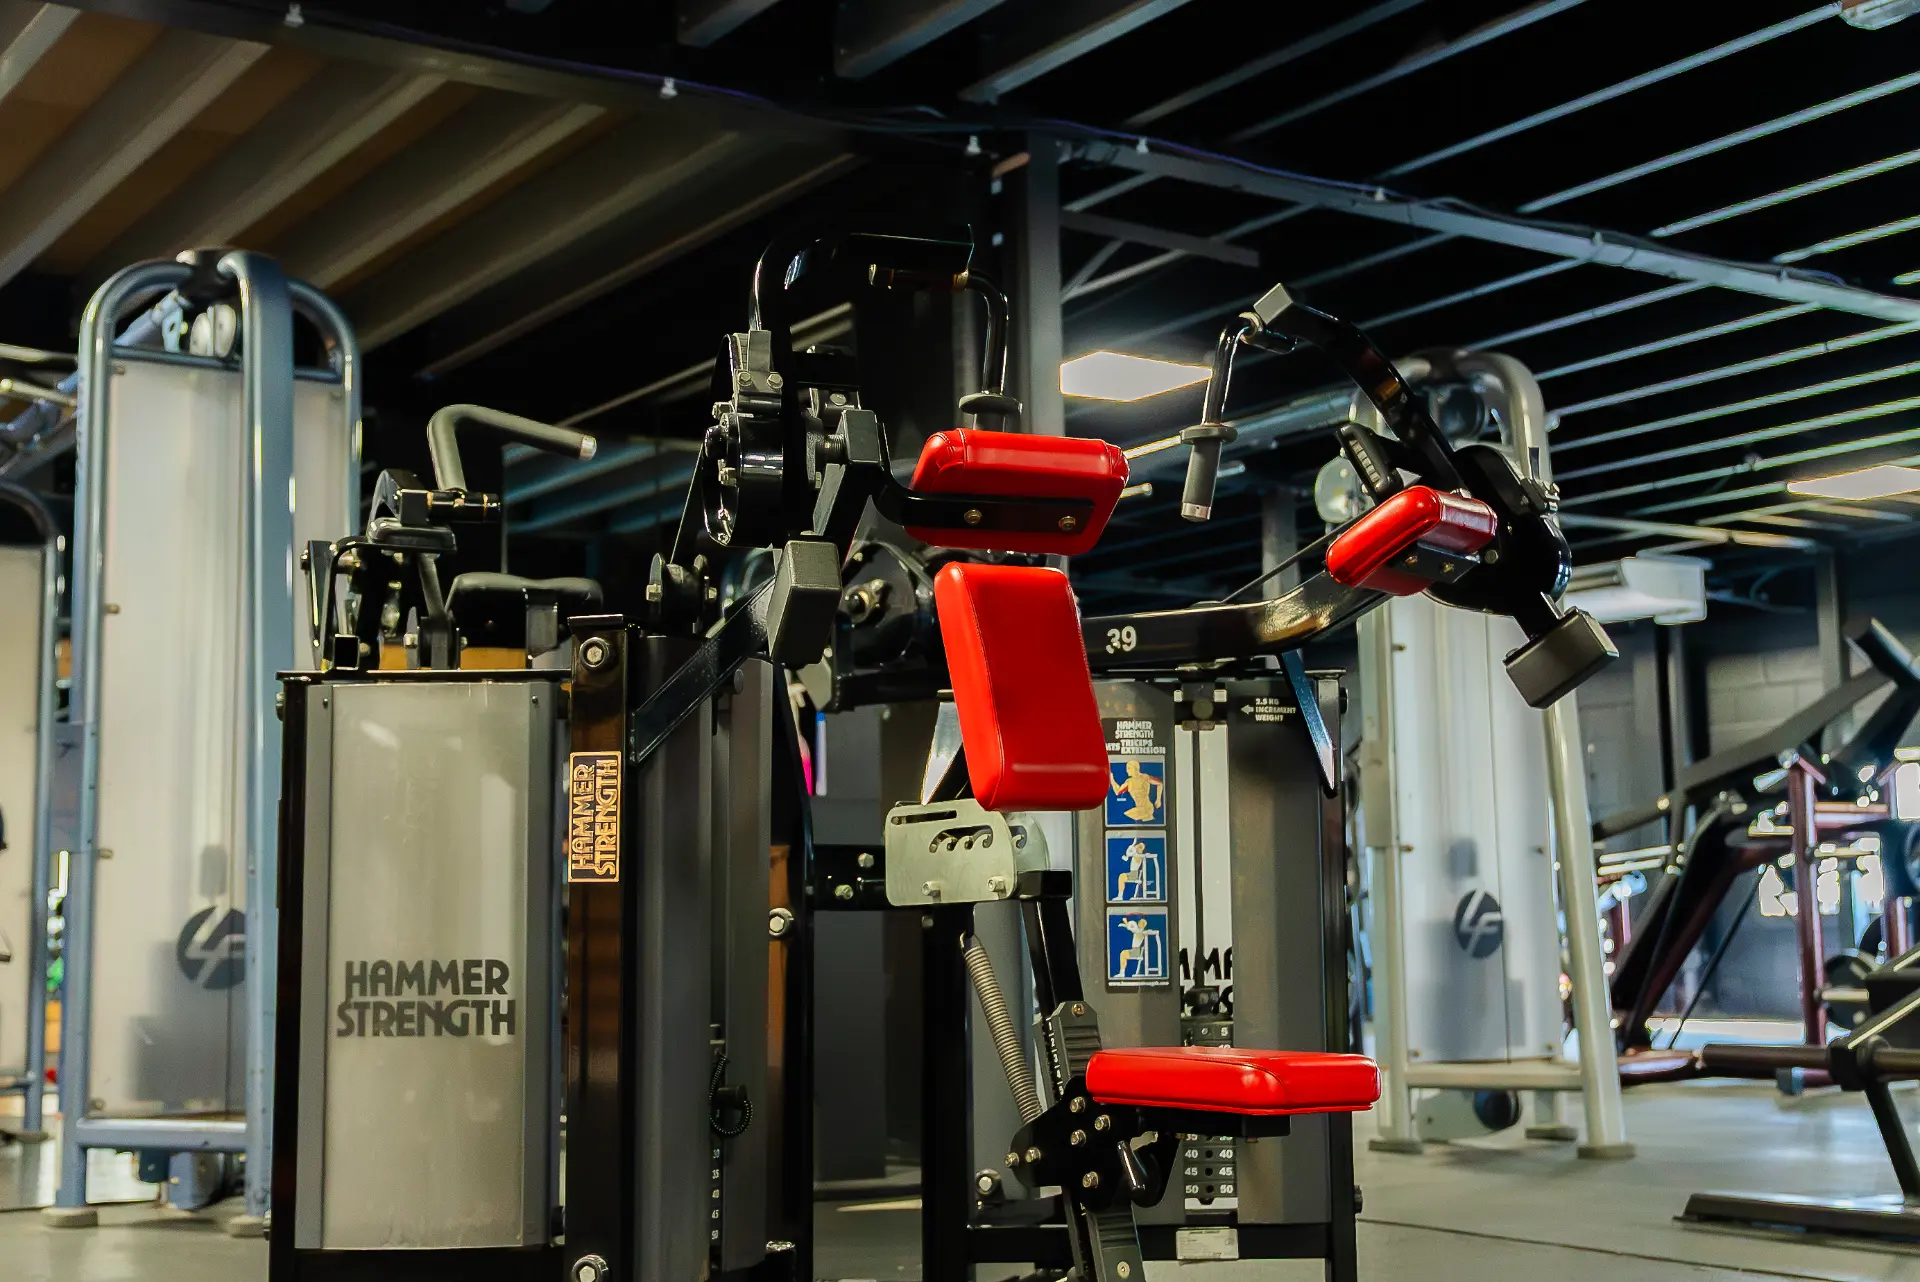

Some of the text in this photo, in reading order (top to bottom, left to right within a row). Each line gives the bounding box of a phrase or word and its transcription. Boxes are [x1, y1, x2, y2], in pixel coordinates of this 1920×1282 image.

[1105, 625, 1137, 654] 39
[1255, 706, 1296, 714] INCREMENT
[1116, 720, 1152, 730] HAMMER
[1115, 729, 1154, 739] STRENGTH
[1120, 739, 1153, 747] TRICEPS
[1121, 746, 1166, 755] EXTENSION
[572, 764, 595, 869] HAMMER
[594, 759, 618, 876] STRENGTH
[345, 959, 510, 997] HAMMER
[337, 999, 517, 1037] STRENGTH
[1184, 1149, 1198, 1158] 40
[1219, 1149, 1233, 1158] 40
[1184, 1167, 1198, 1176] 45
[1219, 1167, 1233, 1176] 45
[1185, 1185, 1199, 1194] 50
[1220, 1185, 1233, 1194] 50
